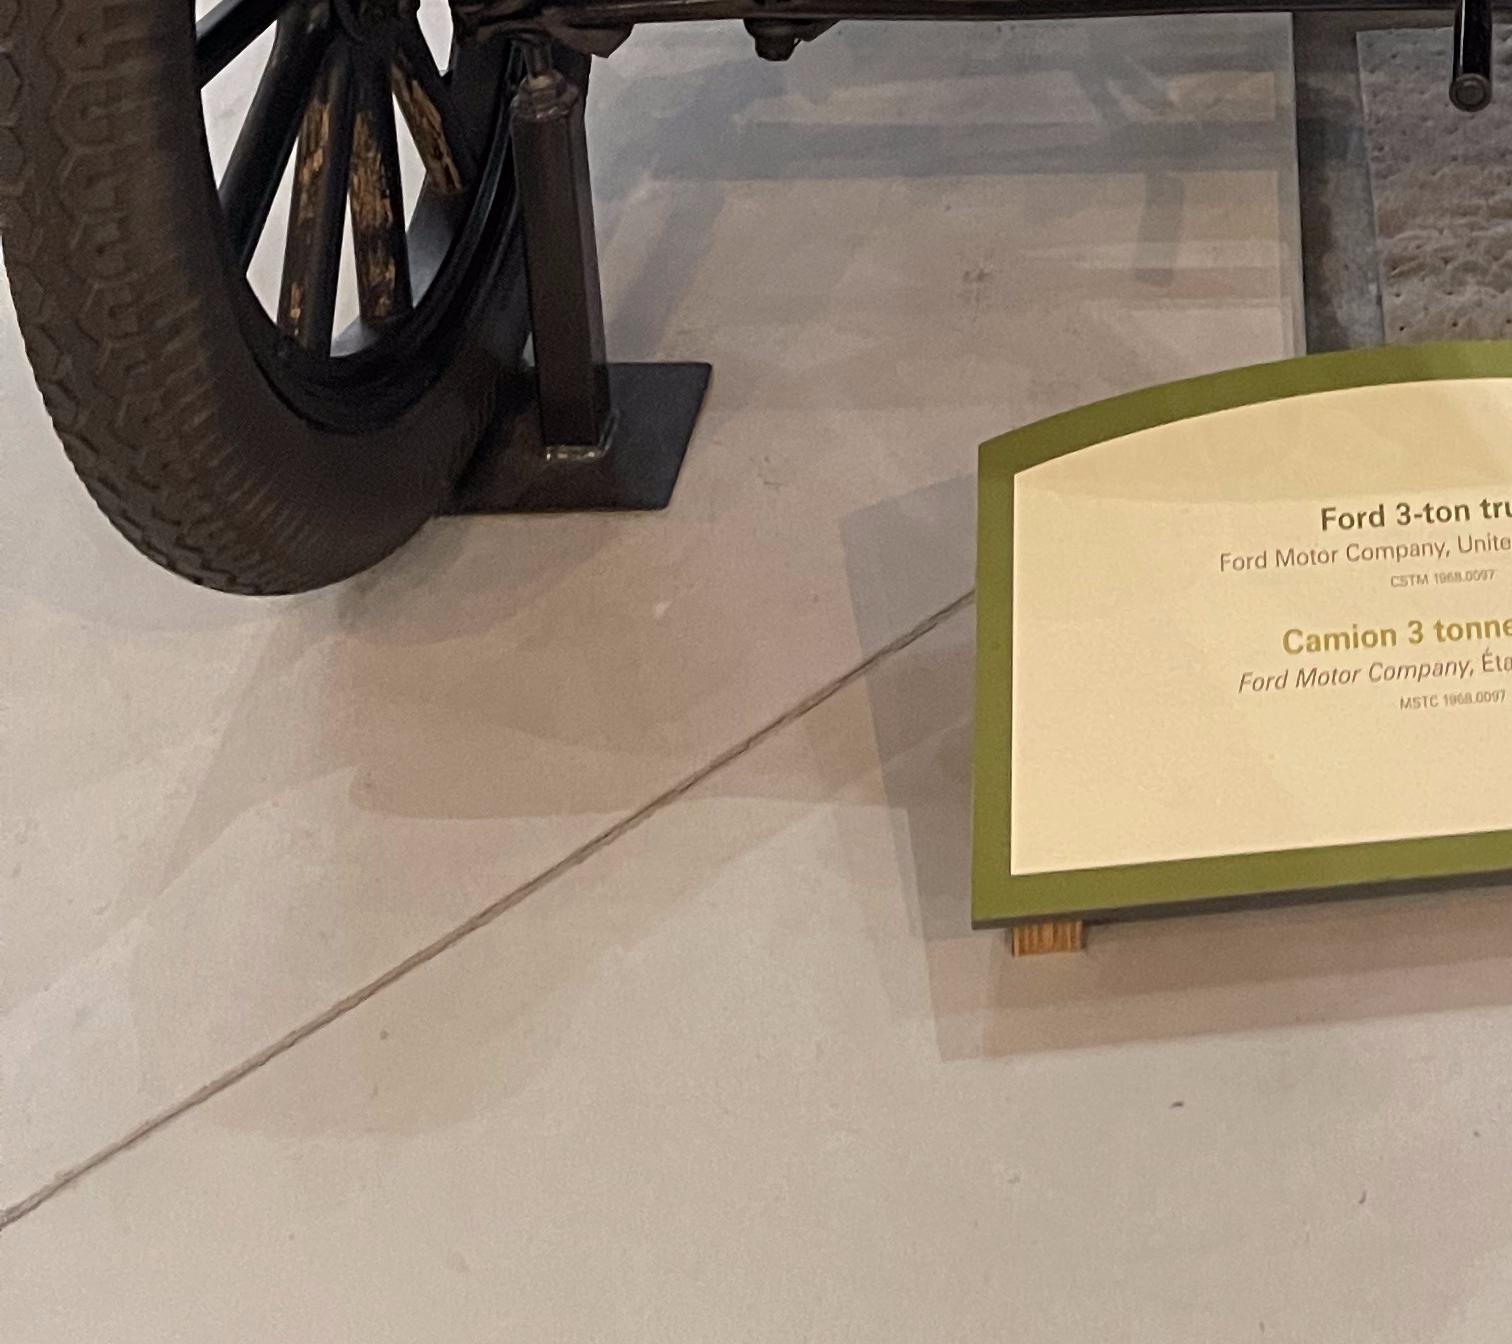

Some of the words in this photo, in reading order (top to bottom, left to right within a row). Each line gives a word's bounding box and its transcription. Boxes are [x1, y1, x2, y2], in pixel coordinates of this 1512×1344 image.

[1320, 503, 1386, 532] Ford
[1395, 501, 1471, 527] 3-ton
[1220, 549, 1268, 573] Ford
[1275, 547, 1339, 568] Motor
[1345, 539, 1451, 563] Company,
[1390, 574, 1430, 589] CSTM
[1282, 623, 1398, 656] Camion
[1407, 619, 1425, 645] 3
[1238, 669, 1290, 694] Ford
[1295, 667, 1362, 690] Motor
[1368, 659, 1475, 683] Company,
[1400, 695, 1439, 711] MSTC
